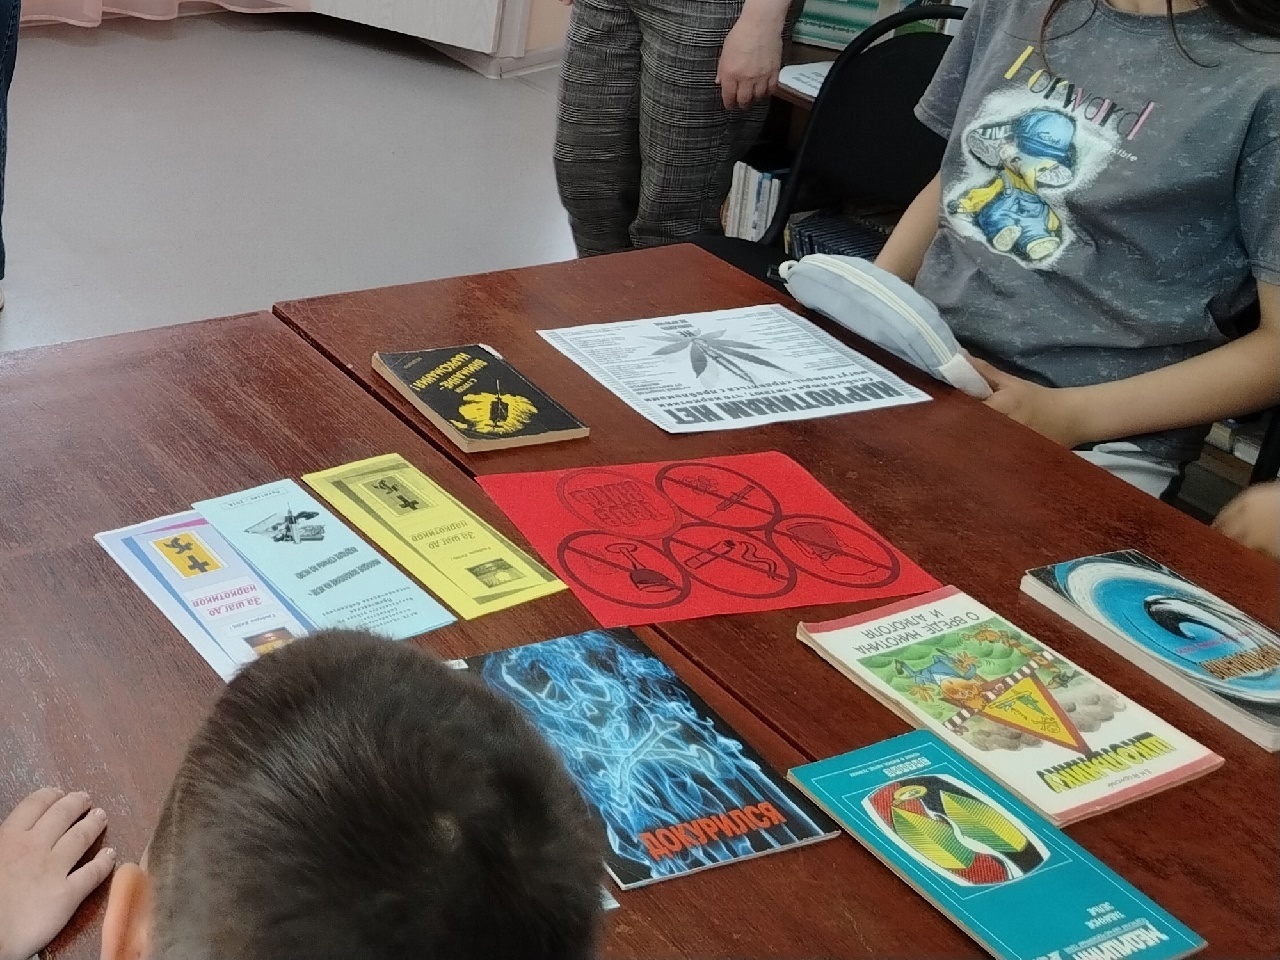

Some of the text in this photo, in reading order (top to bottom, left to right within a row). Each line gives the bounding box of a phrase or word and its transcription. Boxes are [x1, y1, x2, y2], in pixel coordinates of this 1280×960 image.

[663, 403, 726, 425] НЕТ
[713, 380, 905, 420] НАРКОТИКАМ
[410, 520, 469, 542] наркотиков
[427, 531, 476, 550] За шаг до
[191, 583, 258, 608] наркотиков
[207, 596, 262, 617] За шаг до
[852, 611, 980, 655] О ВРЕДЕ НИКОТИНА
[861, 608, 945, 640] И АЛКОГОЛЯ
[1039, 733, 1177, 794] ШКОЛЬНИКУ
[638, 801, 788, 862] ДОКУРИЛСЯ
